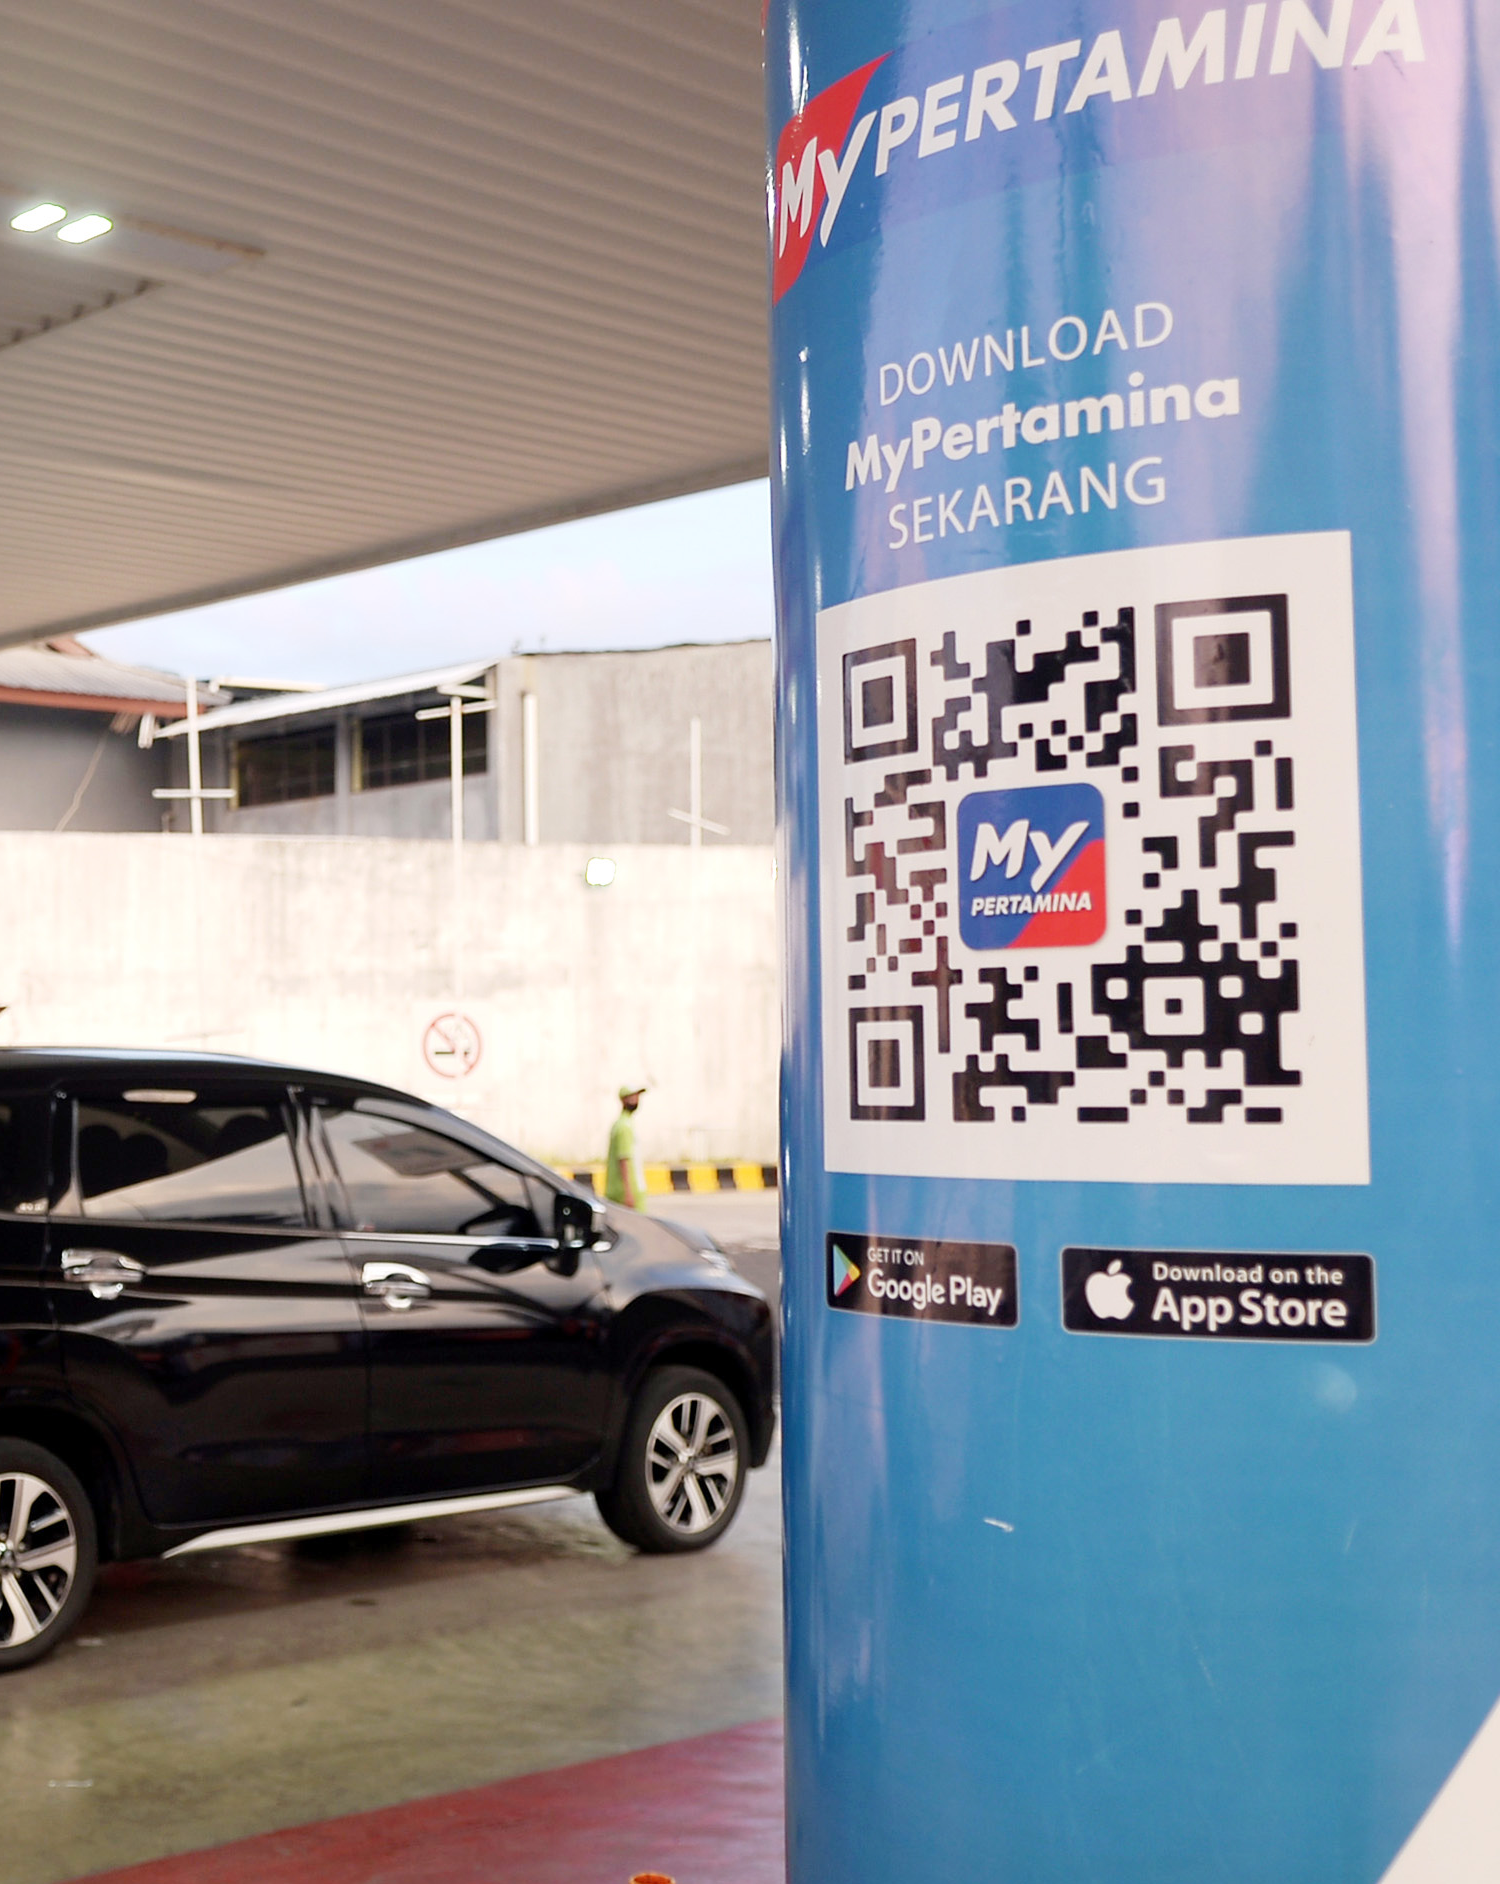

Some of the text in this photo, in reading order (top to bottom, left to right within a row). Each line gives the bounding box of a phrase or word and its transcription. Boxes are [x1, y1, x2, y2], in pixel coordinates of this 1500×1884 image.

[879, 301, 1174, 407] DOWNLOAD
[845, 371, 1240, 493] MyPertamina
[888, 456, 1167, 550] SEKARANG
[969, 818, 1091, 894] My
[970, 891, 1093, 918] PERTAMINA
[867, 1247, 925, 1266] GET IT ON
[1152, 1261, 1344, 1286] Download on the
[866, 1267, 1003, 1317] Google Play
[1151, 1285, 1348, 1333] App Store
